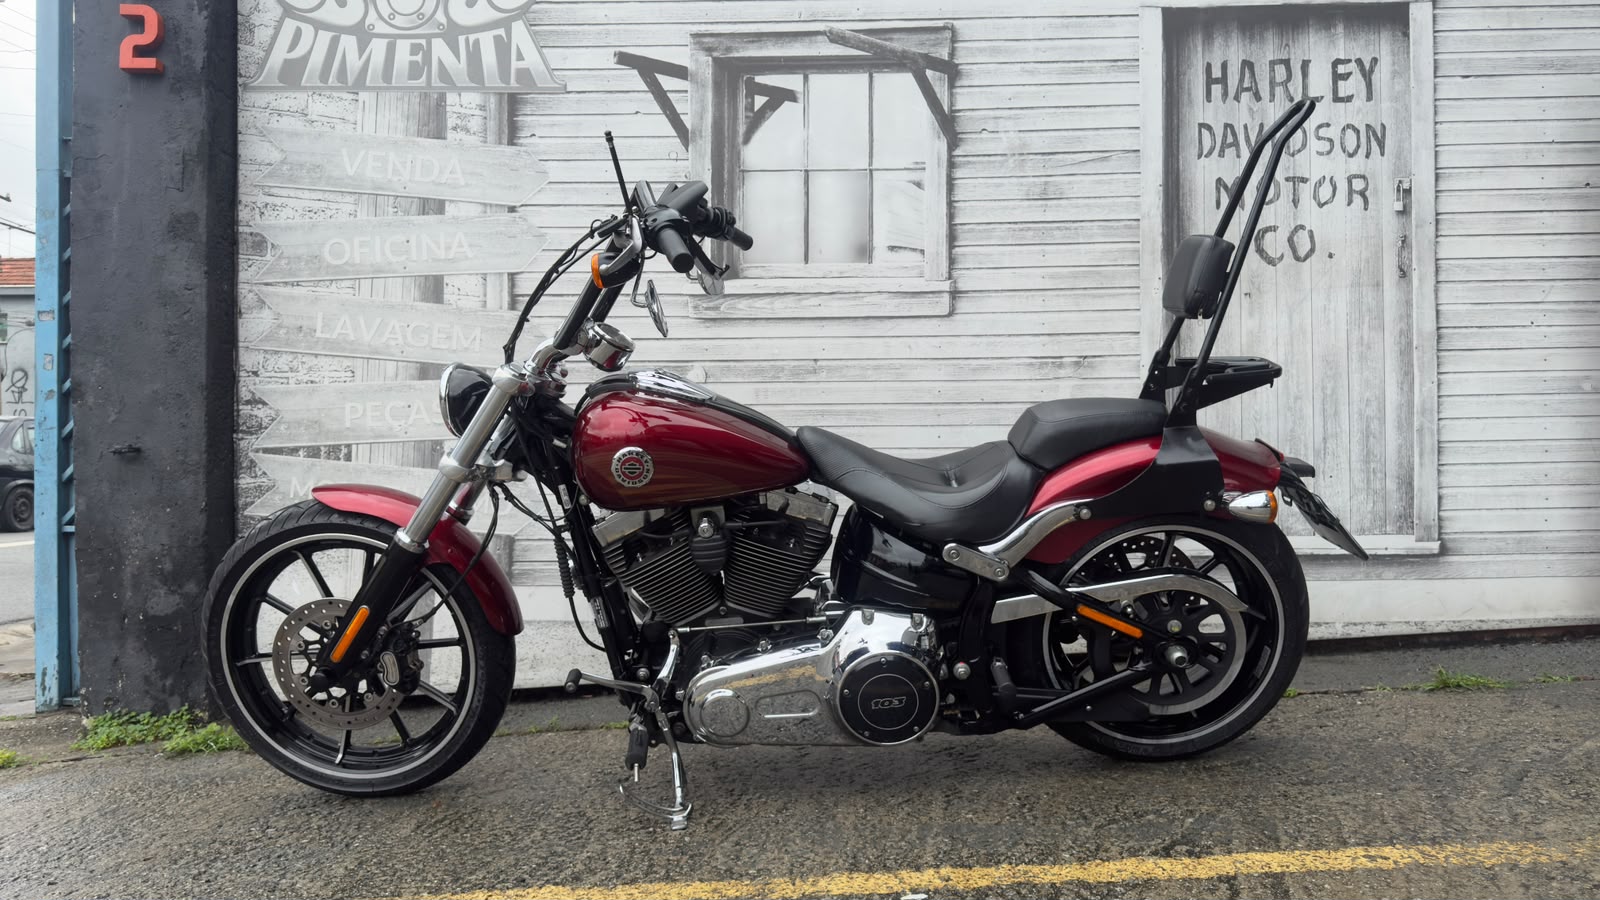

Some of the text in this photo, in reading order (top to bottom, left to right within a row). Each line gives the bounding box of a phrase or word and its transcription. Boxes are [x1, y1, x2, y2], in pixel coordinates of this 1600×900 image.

[119, 4, 164, 72] 2
[250, 16, 564, 88] PIMENTA
[1205, 57, 1379, 103] HARLEY
[1197, 122, 1386, 160] DAVDSON
[341, 148, 466, 186] VENDA
[323, 231, 474, 267] OFICINA
[1254, 224, 1335, 267] CO.
[315, 312, 482, 350] LAVAGEM
[871, 696, 906, 709] 103
